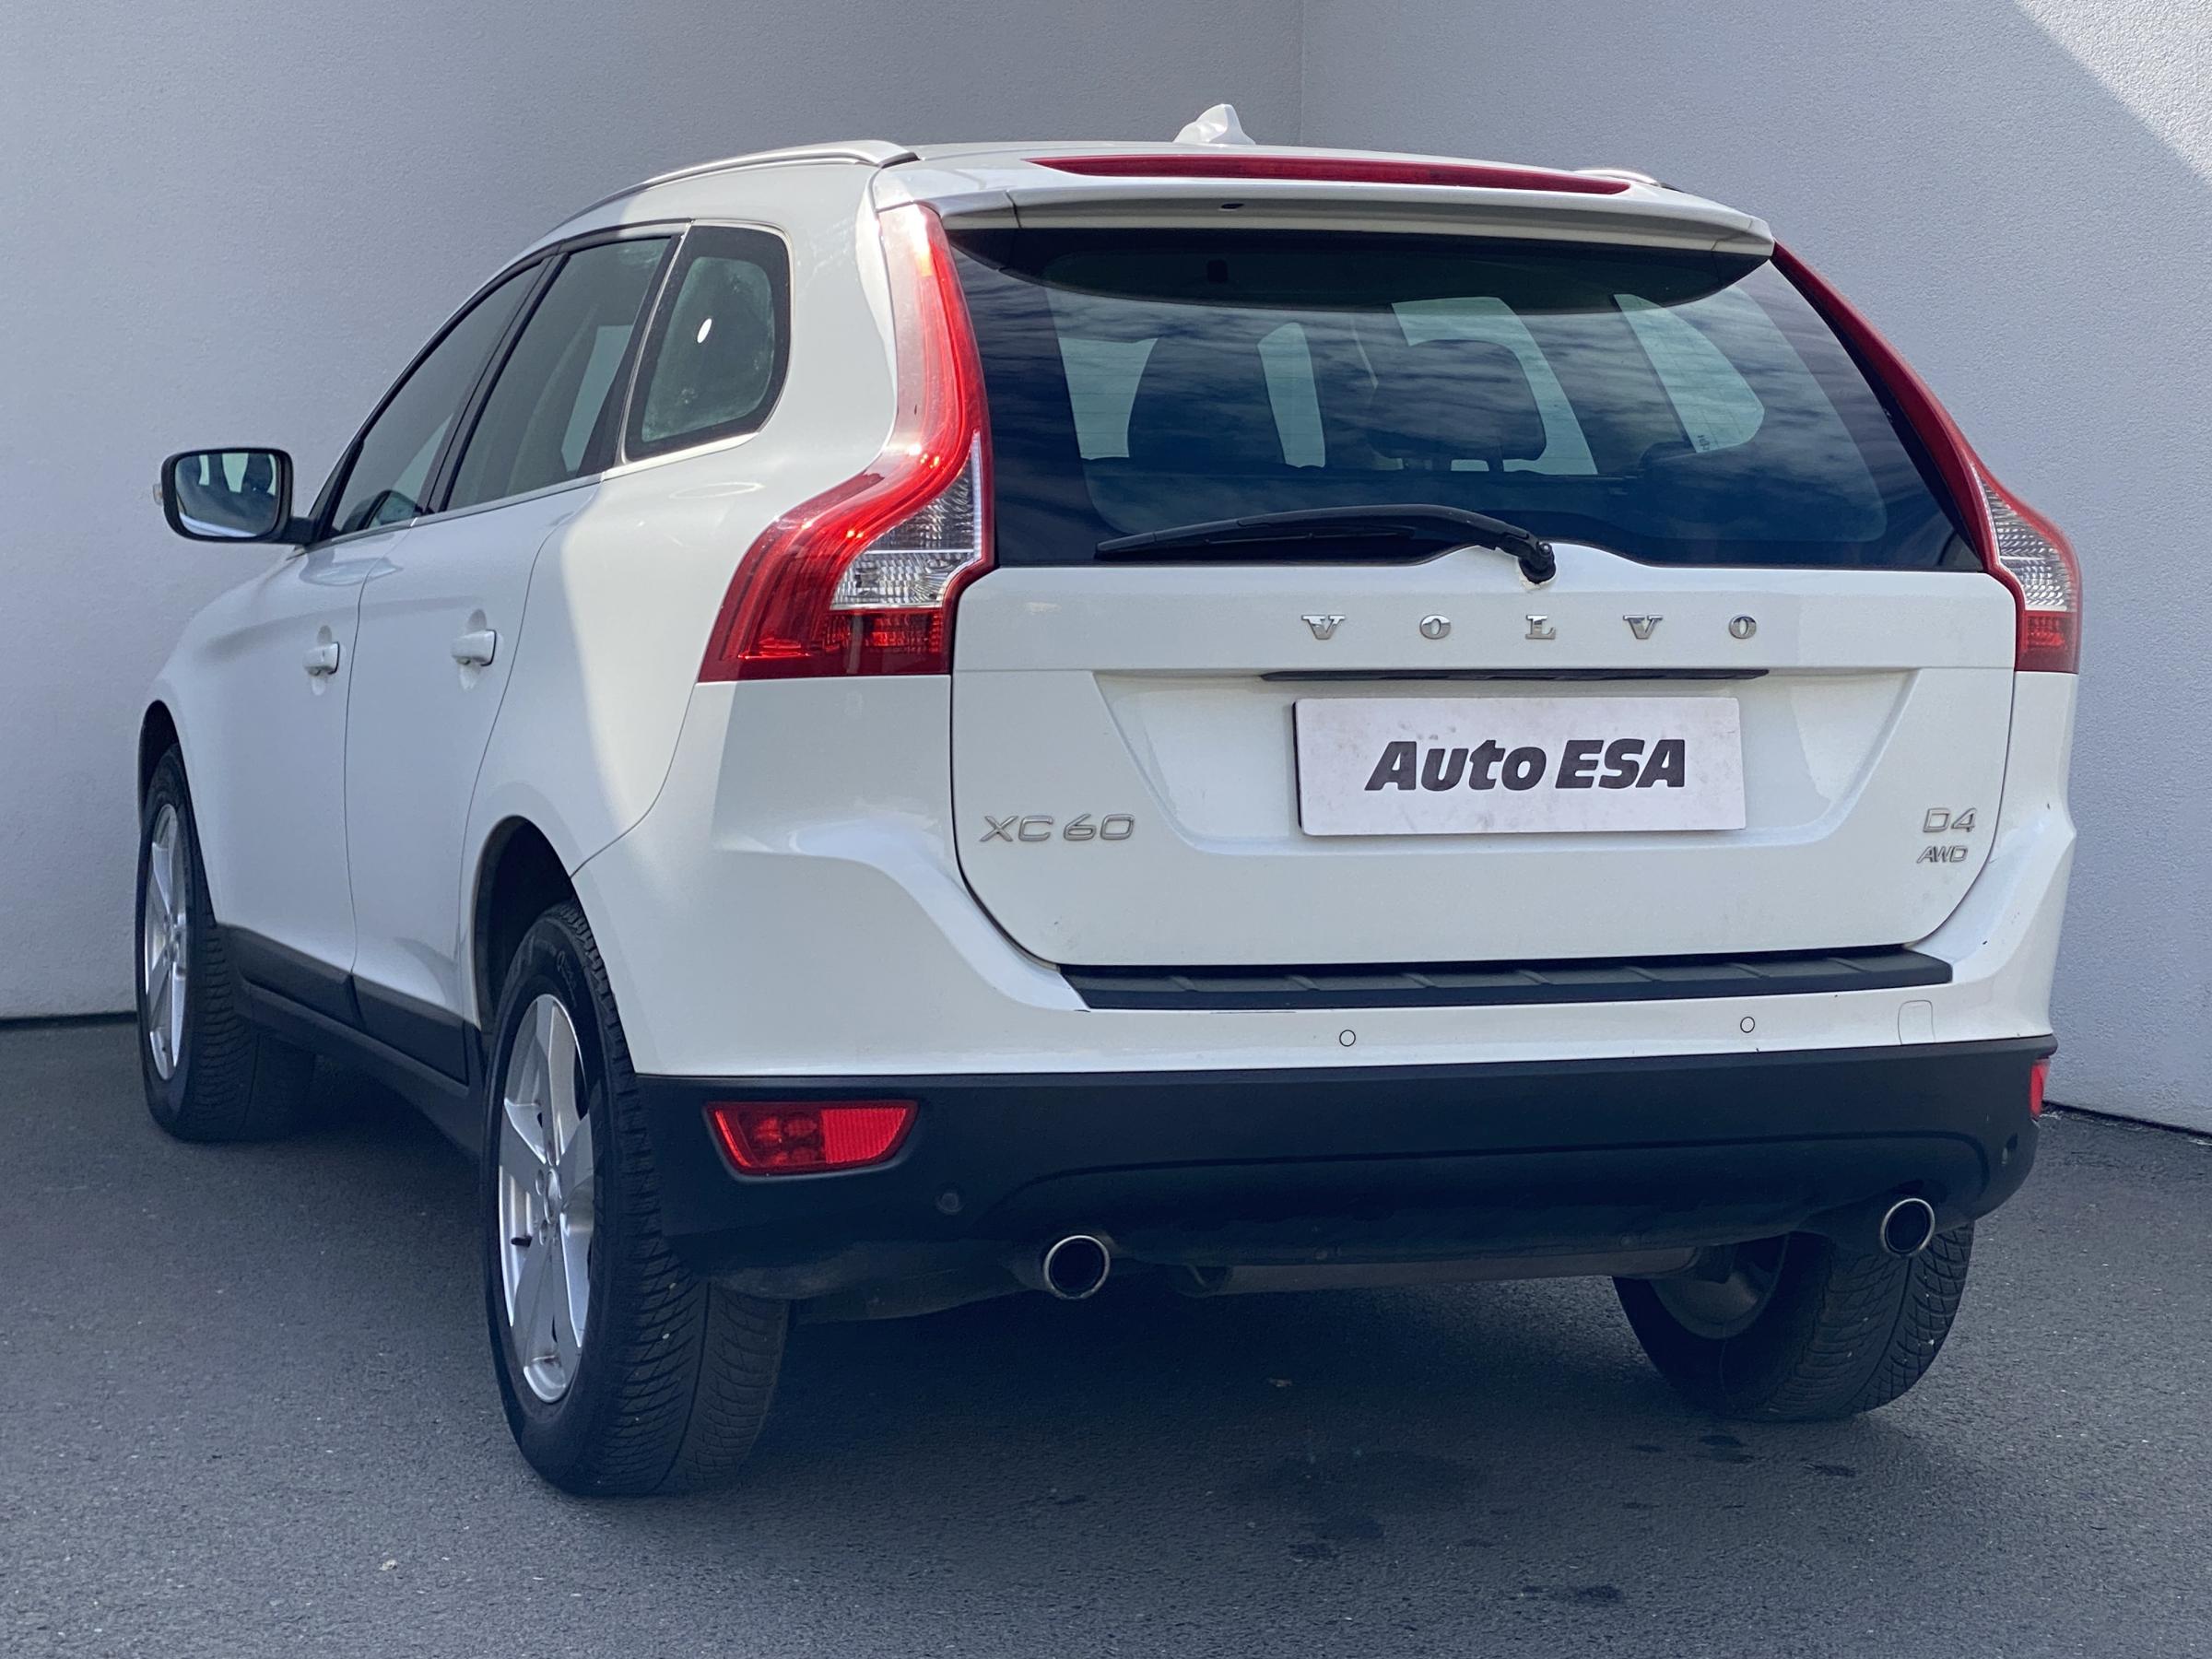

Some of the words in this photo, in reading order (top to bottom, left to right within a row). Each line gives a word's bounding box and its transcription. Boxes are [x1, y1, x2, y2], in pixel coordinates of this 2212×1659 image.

[1301, 614, 1758, 640] VOLVO
[1364, 739, 1547, 791] Auto
[1555, 738, 1686, 789] ESA
[1923, 806, 1978, 833] D4
[1916, 845, 1969, 864] AWD
